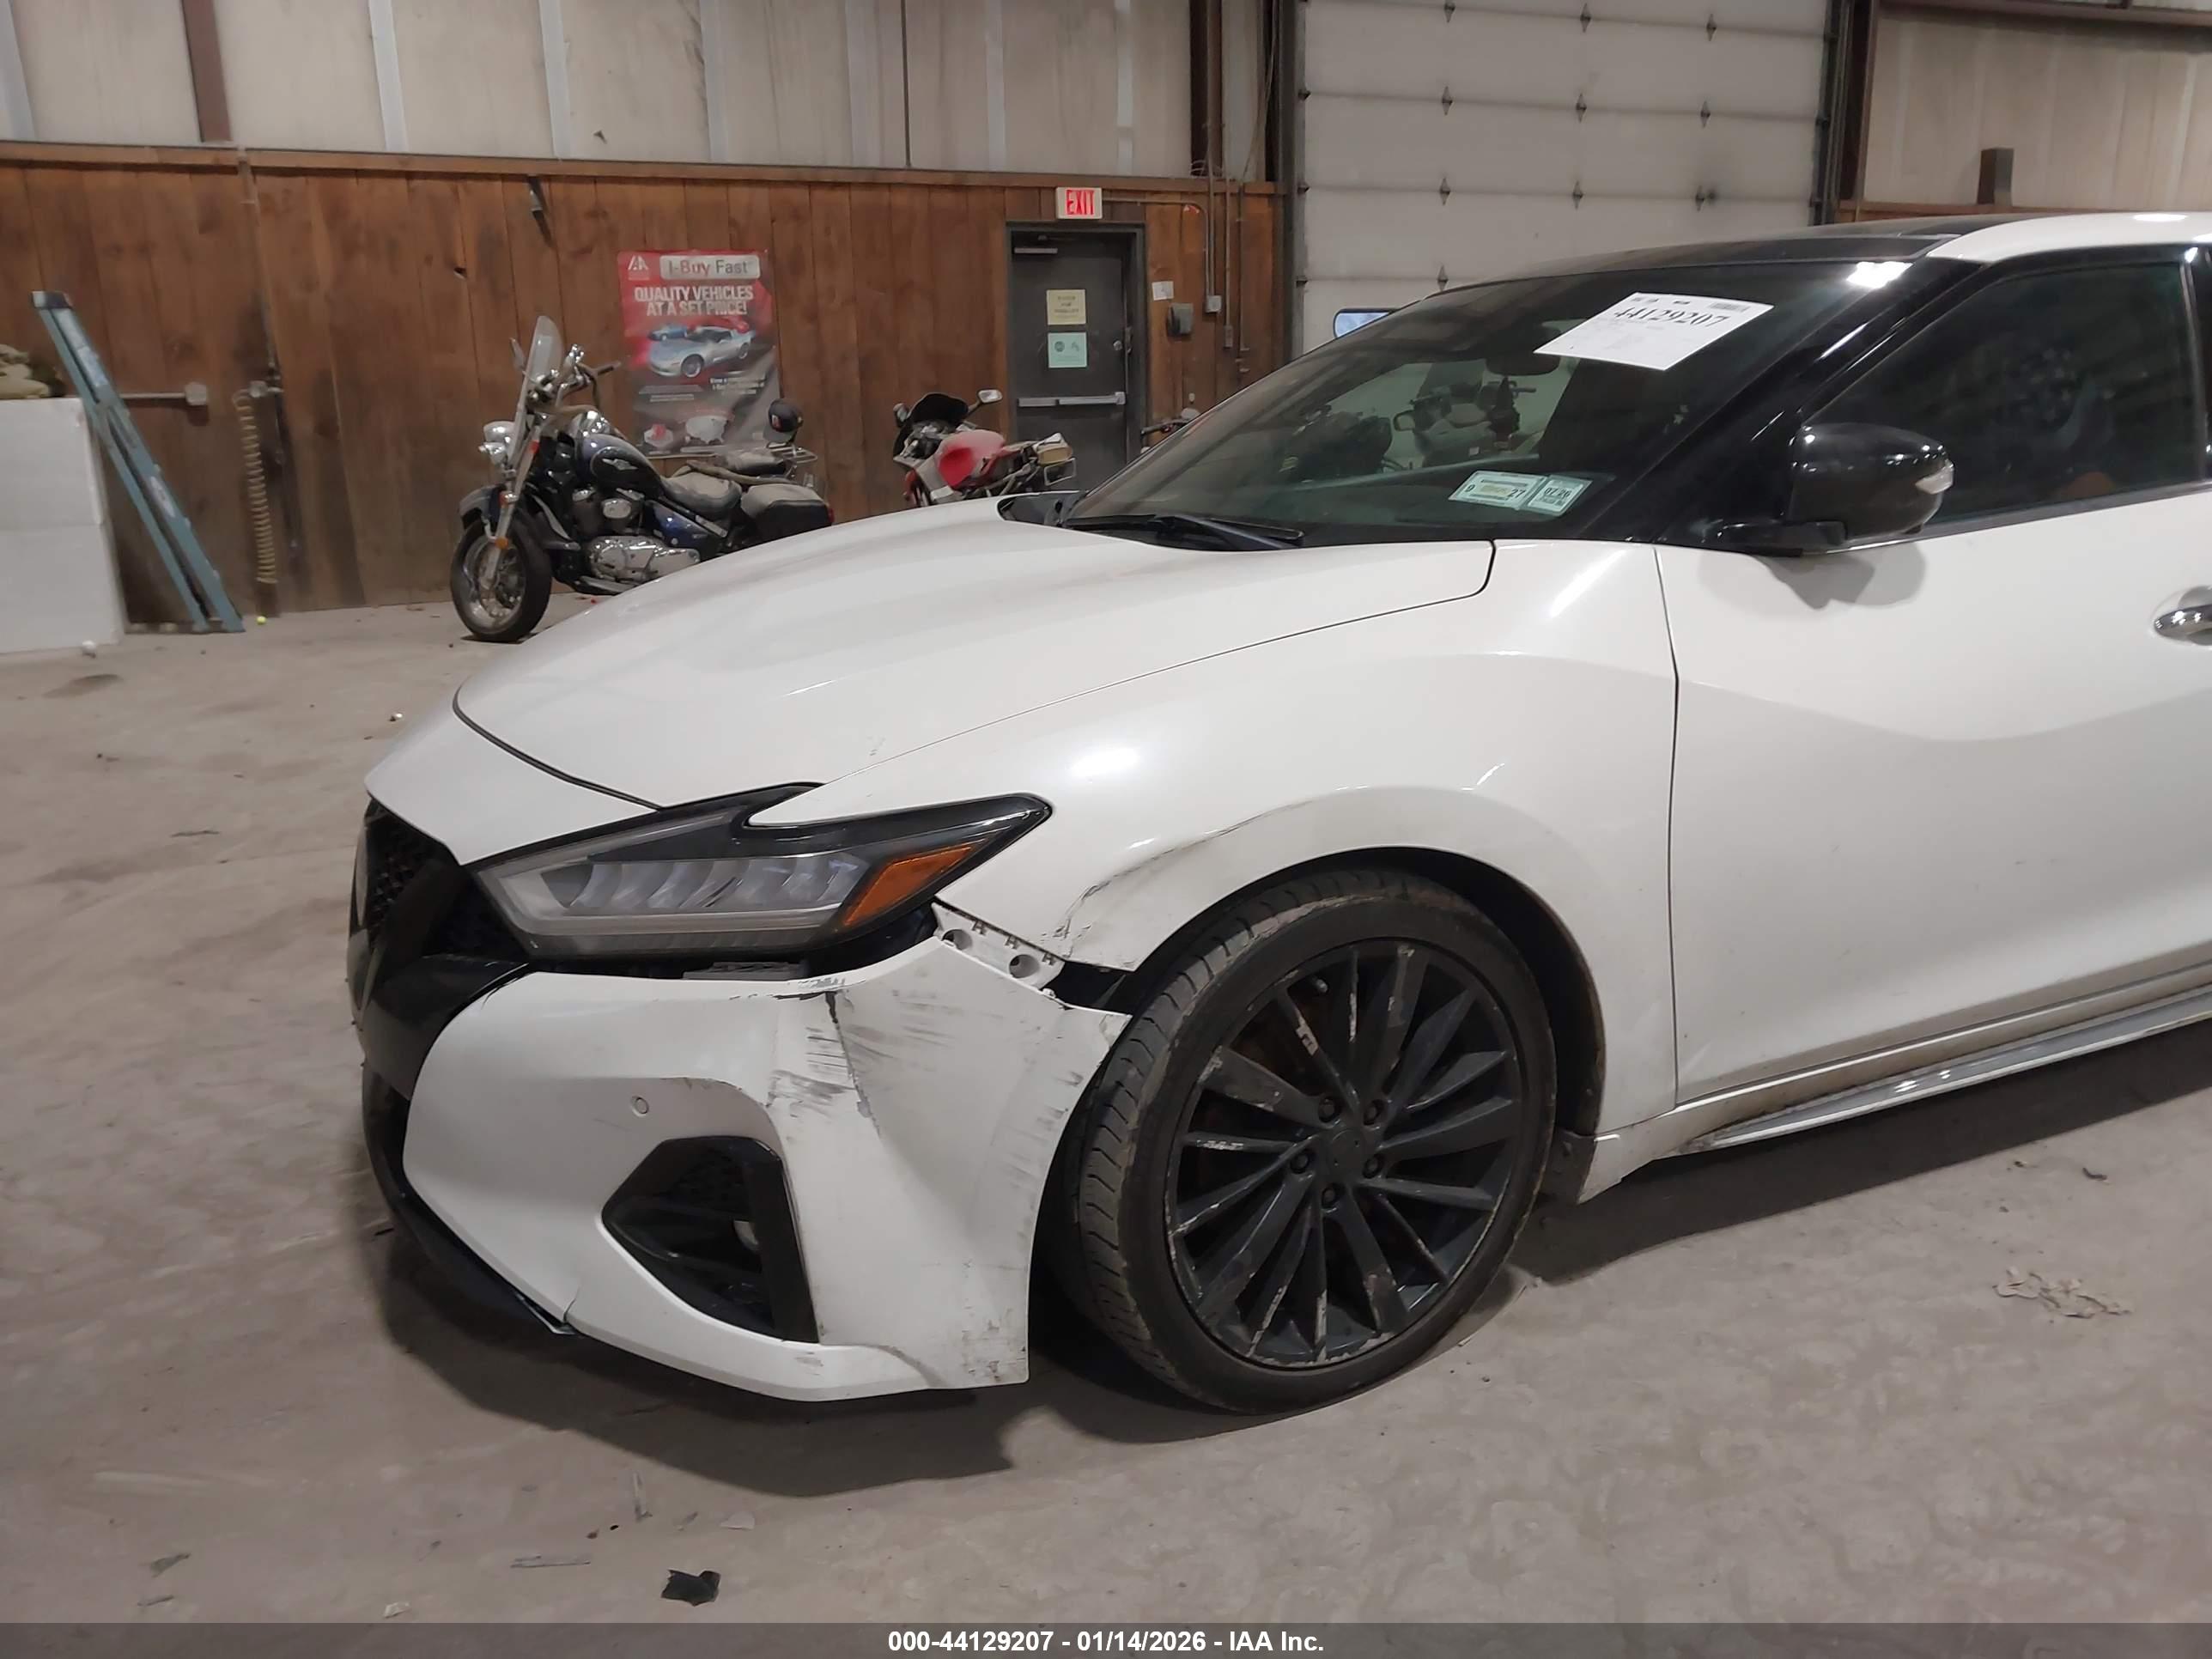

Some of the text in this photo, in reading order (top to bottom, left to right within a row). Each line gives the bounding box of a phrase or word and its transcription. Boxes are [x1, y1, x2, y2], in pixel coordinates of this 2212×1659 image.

[1066, 189, 1095, 216] EXIT
[668, 259, 749, 276] I-Buy Fast
[634, 285, 754, 301] QUALITY VEHICLES
[647, 301, 665, 317] AT
[666, 301, 678, 317] A
[679, 301, 703, 316] SET
[1613, 306, 1732, 327] 44129207
